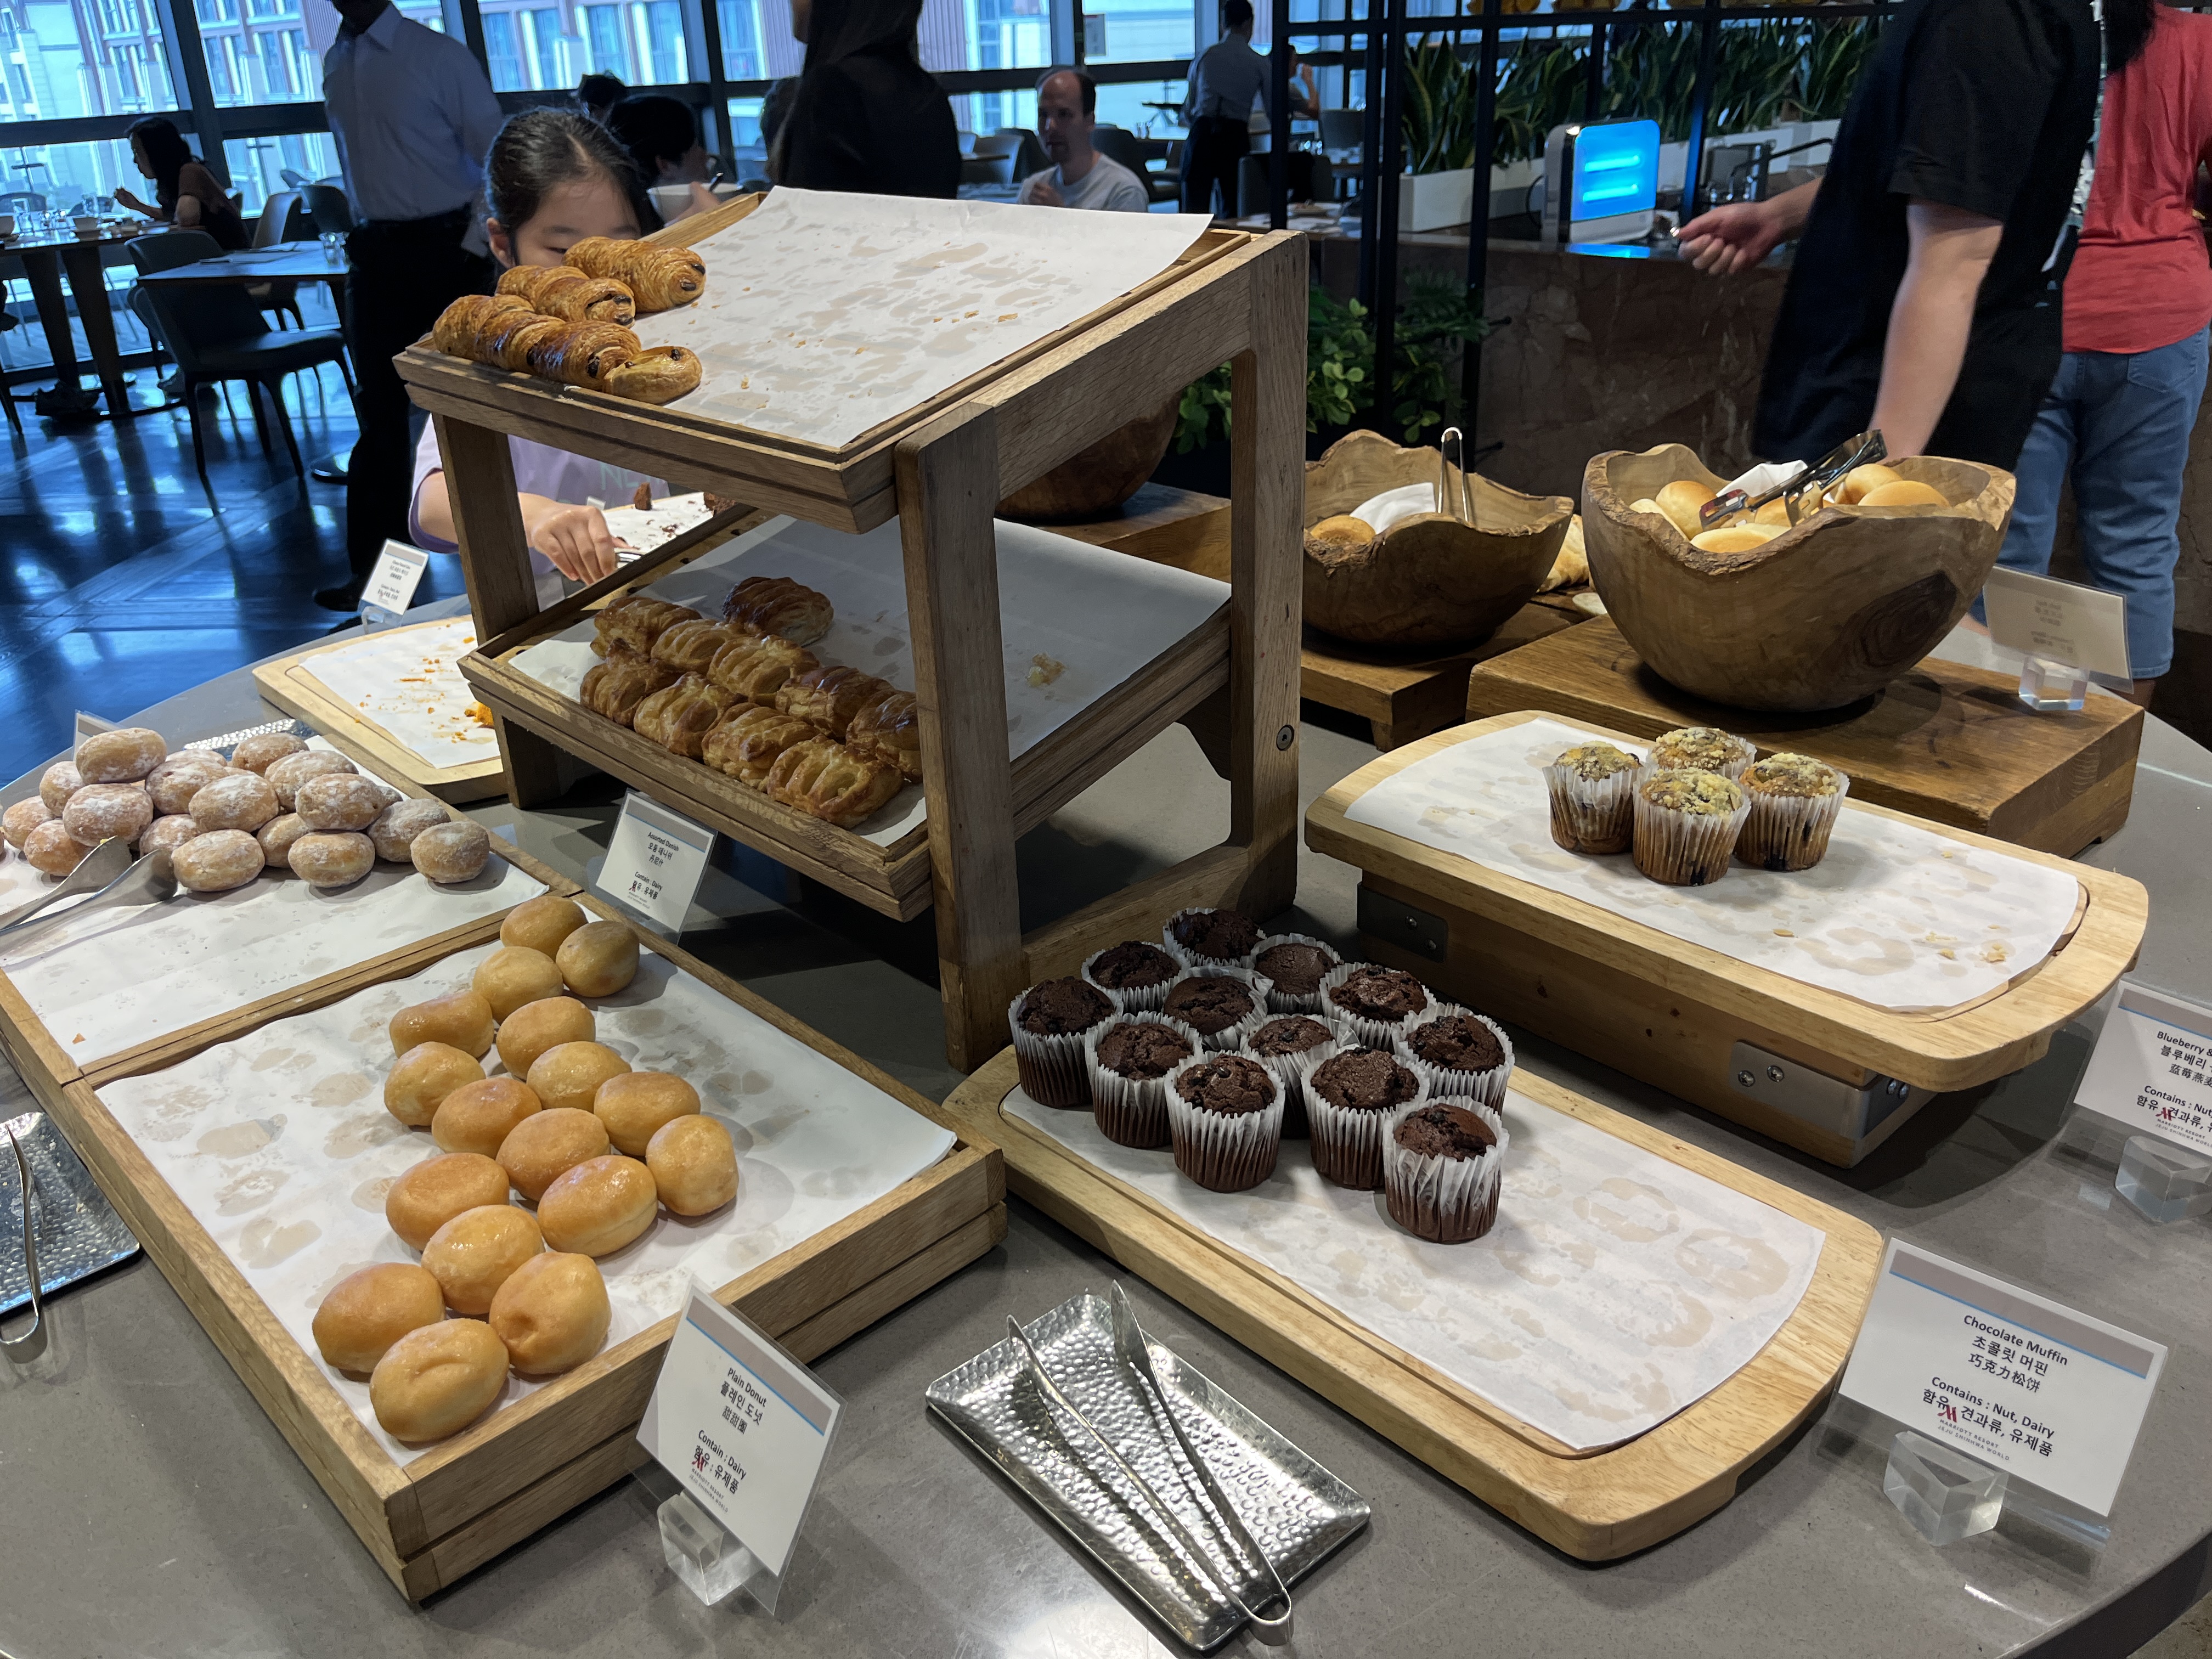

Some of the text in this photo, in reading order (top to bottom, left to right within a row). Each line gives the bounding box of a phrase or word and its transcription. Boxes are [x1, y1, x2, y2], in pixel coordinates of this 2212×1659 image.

[647, 832, 679, 851] Assorted Danish
[652, 880, 663, 892] Dairy
[2157, 1031, 2205, 1054] Blueberry
[2160, 1045, 2207, 1070] 블루베리
[2136, 1094, 2159, 1111] 함유
[2144, 1085, 2186, 1107] Contains
[2157, 1119, 2206, 1139] MARRIOTT RESORT
[2169, 1128, 2194, 1141] SHINHWA
[1963, 1314, 2068, 1365] Chocolate Muffin
[1972, 1335, 2049, 1377] 초콜릿 머핀
[727, 1367, 768, 1408] Plain Donut
[1967, 1353, 2041, 1393] 巧克力松饼
[720, 1380, 764, 1426] 플레인 도넛
[1931, 1376, 1983, 1407] Contains
[1992, 1403, 2018, 1424] Nut,
[2021, 1415, 2055, 1440] Dairy
[721, 1405, 748, 1435] 甜甜圈
[1922, 1388, 2053, 1458] 함유 견과류, 유제품
[1939, 1419, 2000, 1449] MARRIOTT RESORT
[698, 1429, 724, 1459] Contain
[727, 1455, 747, 1481] Dairy
[1937, 1425, 2010, 1462] JEJU SHINHWA WORLD
[709, 1483, 725, 1500] RESORT
[714, 1464, 740, 1494] 유제품
[715, 1498, 729, 1513] WORLD
